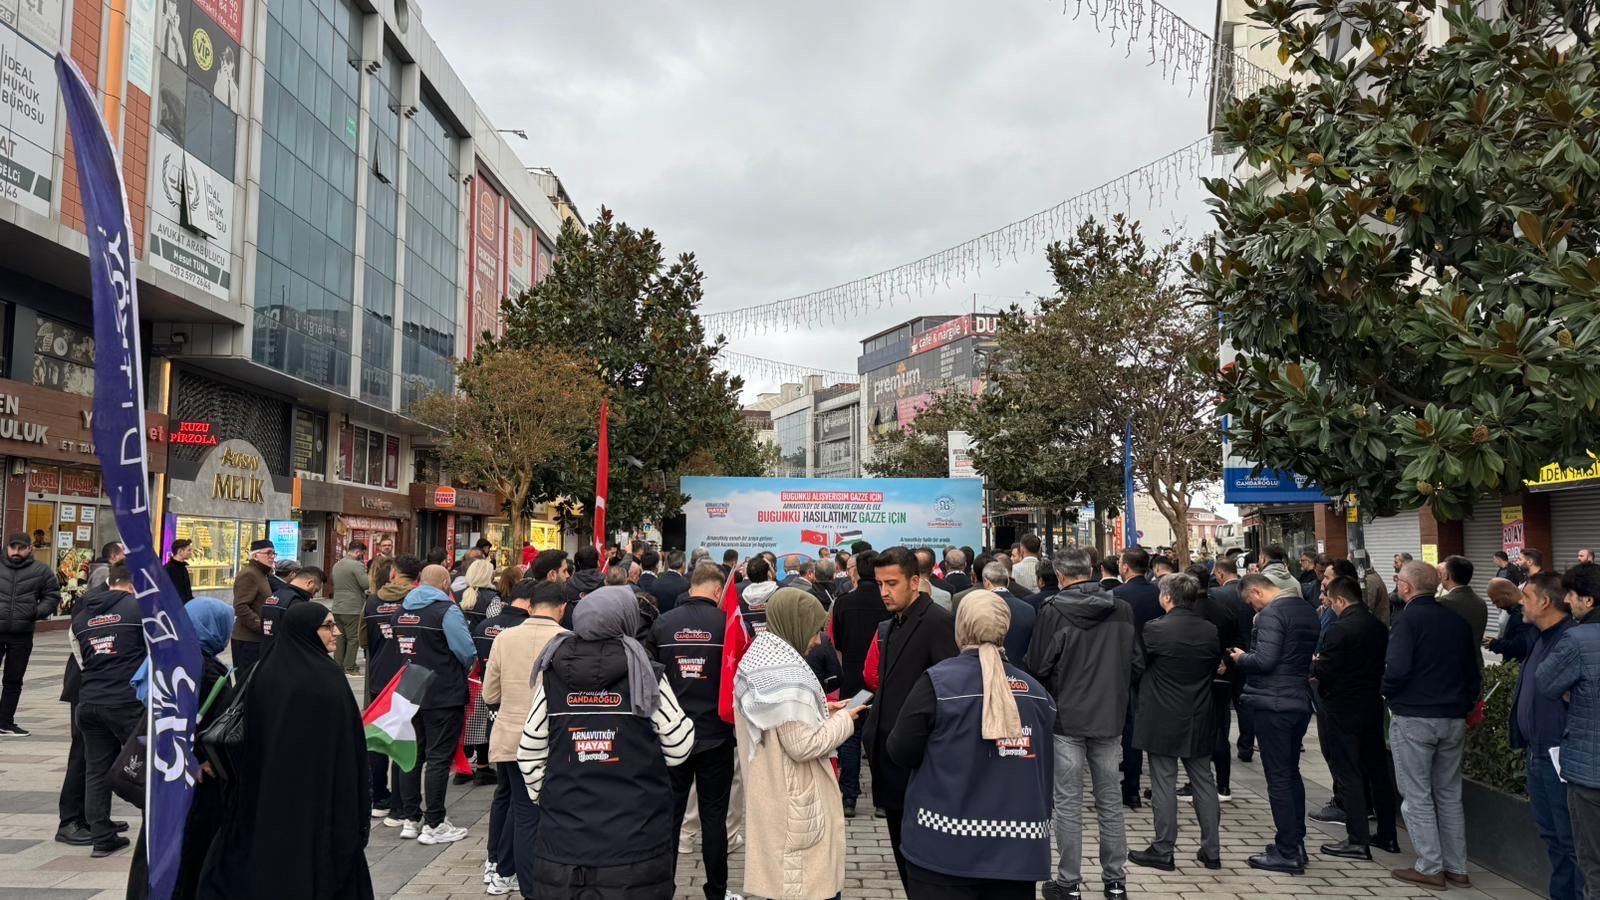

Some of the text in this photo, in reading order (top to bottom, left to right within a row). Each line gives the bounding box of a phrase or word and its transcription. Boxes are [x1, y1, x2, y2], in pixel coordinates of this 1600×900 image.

[4, 50, 35, 84] İDEAL
[2, 69, 40, 105] HUKUK
[2, 90, 45, 125] BÜROSU
[157, 223, 225, 266] AVUKAT ARABULUCU
[173, 250, 209, 276] Mesut TUNA
[170, 433, 217, 446] PİRZOLA
[180, 422, 209, 433] KUZU
[212, 474, 265, 504] MELİK
[859, 512, 886, 523] GAZZE
[889, 512, 906, 524] İÇİN
[572, 729, 616, 741] ARNAVUTKÖY
[577, 741, 610, 750] HAYAT
